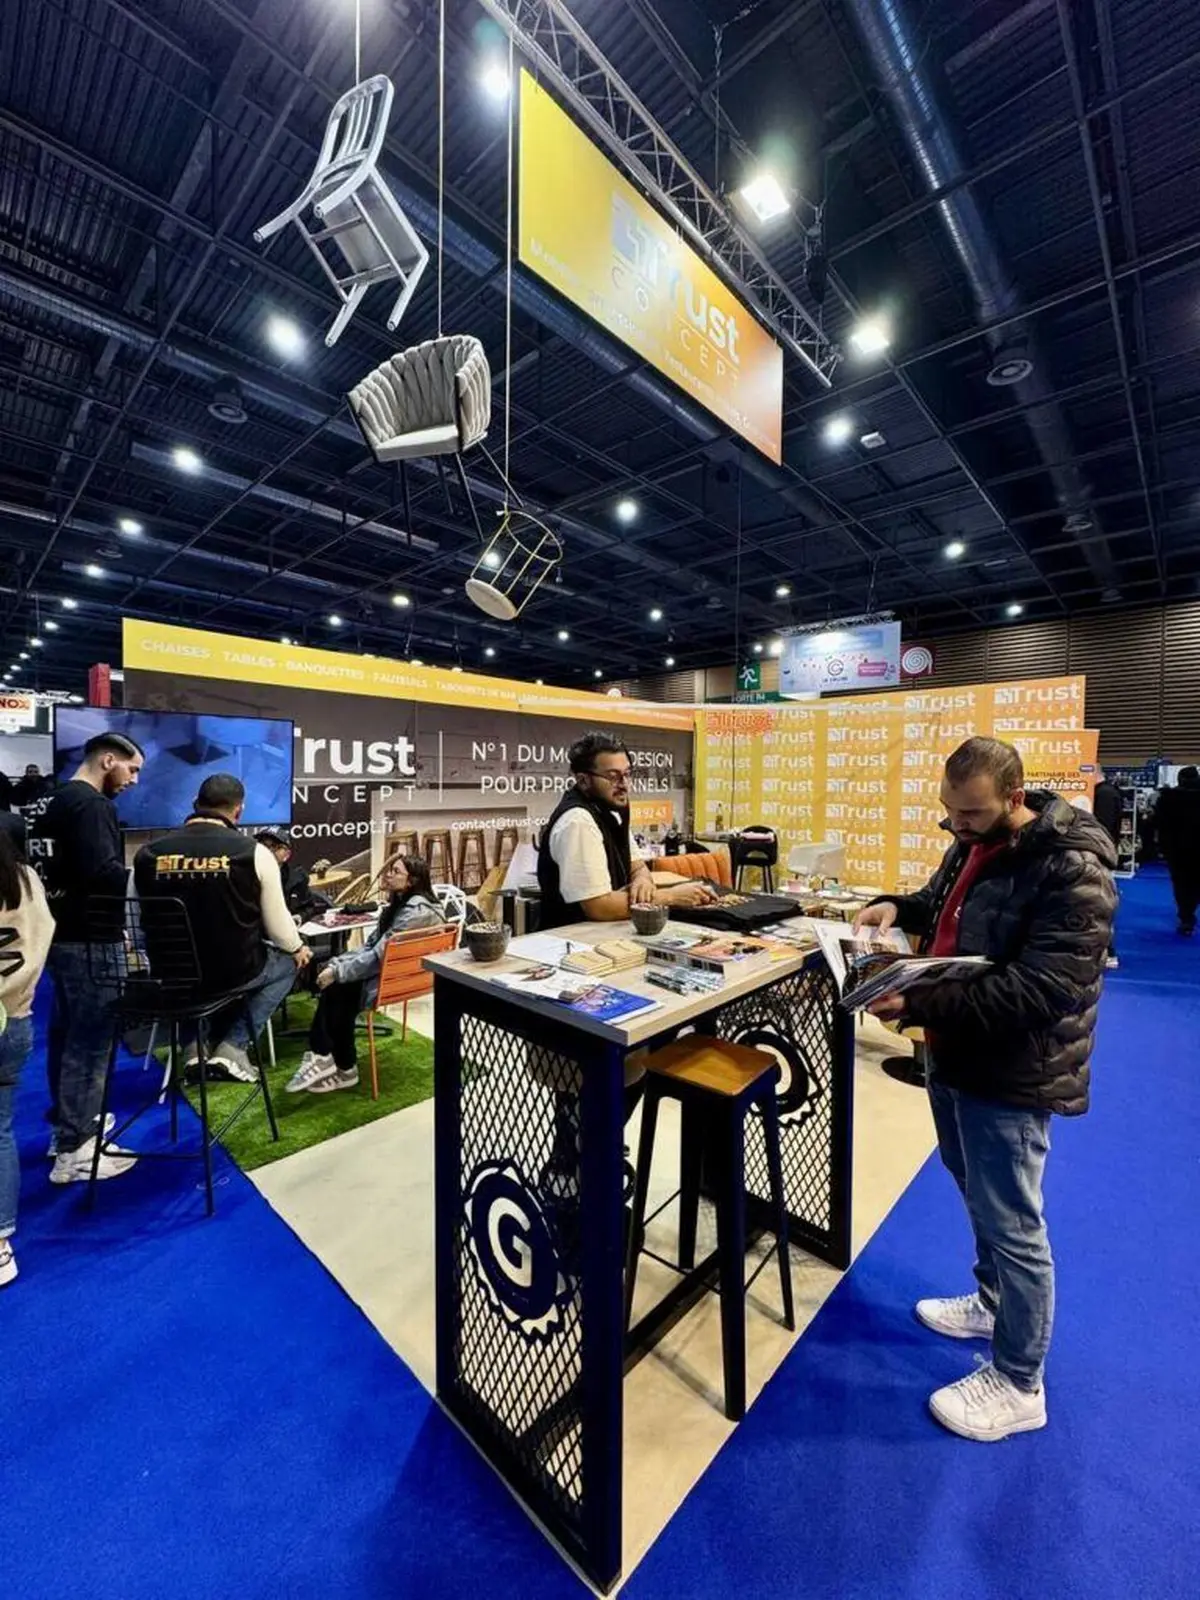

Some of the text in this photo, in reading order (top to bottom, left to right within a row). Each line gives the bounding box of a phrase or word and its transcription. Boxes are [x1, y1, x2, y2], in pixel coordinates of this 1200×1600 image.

[638, 222, 740, 364] Trust
[140, 638, 211, 660] CHAISES
[223, 651, 276, 669] TABLES
[285, 659, 365, 682] BANQUETTES
[918, 691, 976, 710] Trust
[1013, 682, 1082, 703] Trust
[918, 720, 976, 739] Trust
[1012, 715, 1079, 730] Trust
[772, 730, 816, 745] Trust
[841, 726, 889, 742] Trust
[294, 727, 416, 775] rust
[1027, 737, 1082, 754] Trust
[518, 745, 544, 763] DU
[629, 751, 673, 769] DESIGN
[772, 754, 815, 770] Trust
[840, 752, 888, 767] Trust
[481, 776, 536, 795] POUR
[772, 778, 813, 793] Trust
[840, 778, 888, 794] Trust
[1023, 779, 1088, 791] anchises
[292, 785, 416, 804] NCEPT
[771, 802, 813, 818] Trust
[839, 804, 887, 820] Trust
[780, 828, 813, 842] rust
[838, 829, 886, 847] Trust
[170, 854, 230, 870] Trust
[845, 857, 886, 874] rust
[487, 1196, 533, 1289] G
